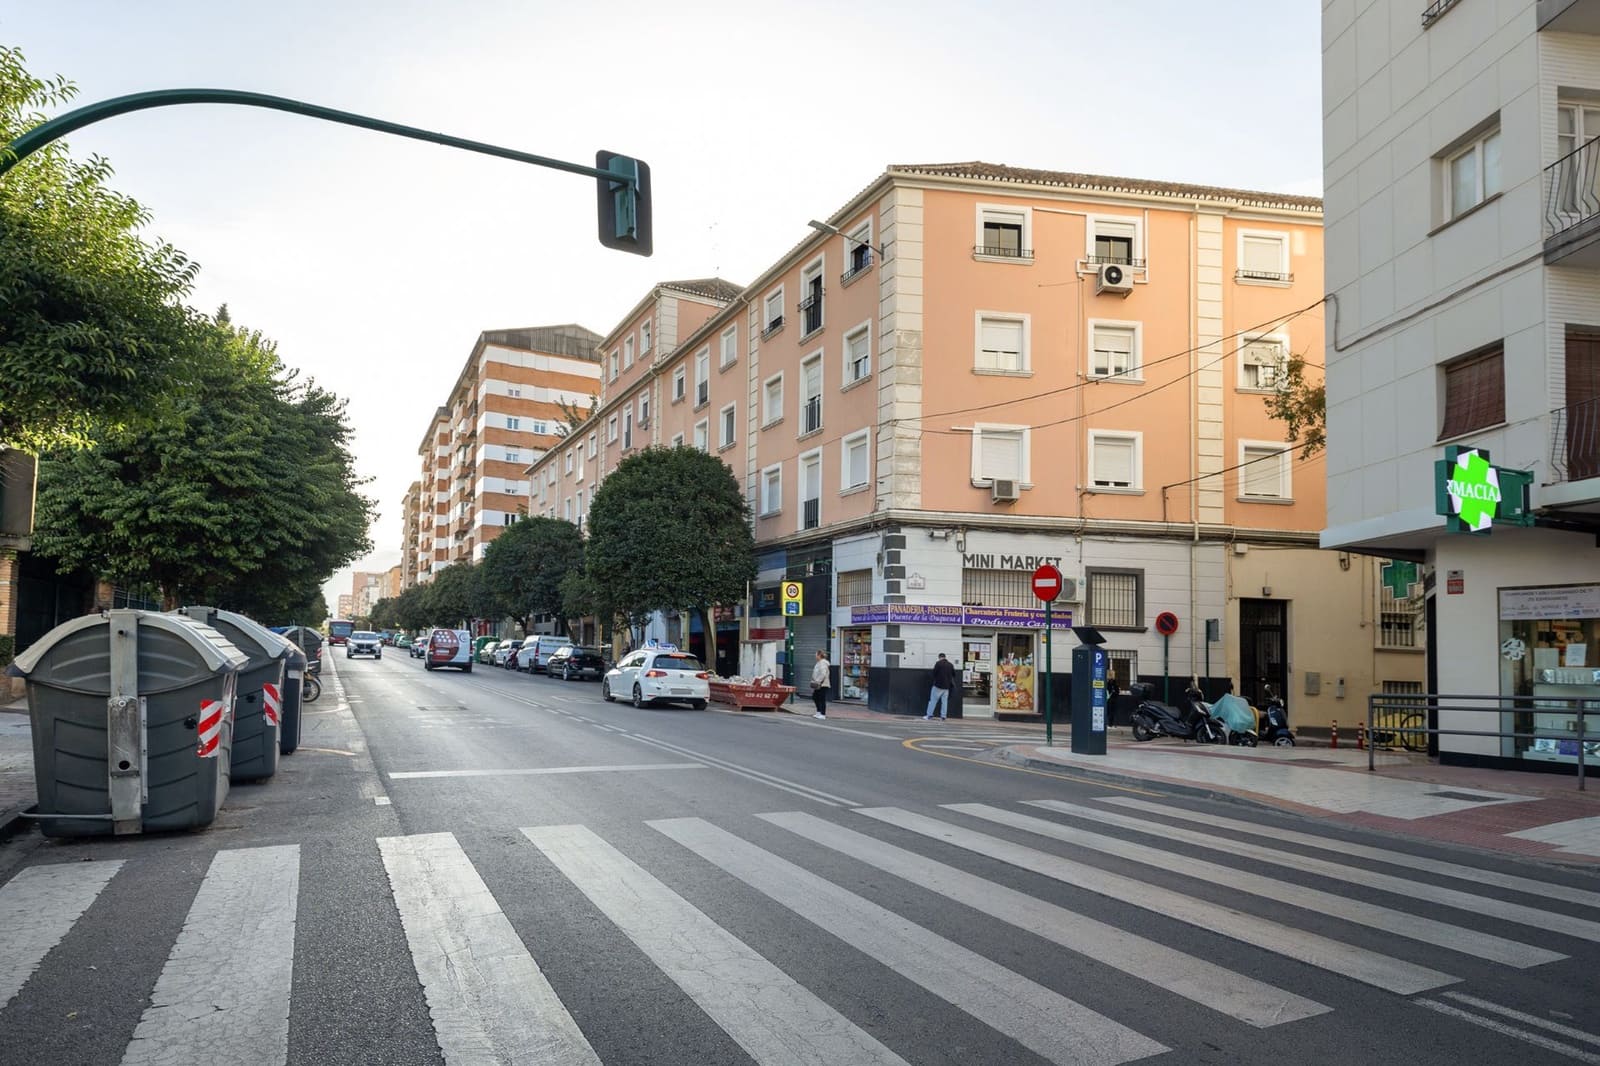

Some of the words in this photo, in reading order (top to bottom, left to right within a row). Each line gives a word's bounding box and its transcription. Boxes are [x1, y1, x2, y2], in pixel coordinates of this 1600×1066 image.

[962, 553, 994, 568] MINI
[1000, 554, 1062, 570] MARKET
[970, 617, 1025, 626] Productos
[1095, 652, 1102, 663] P
